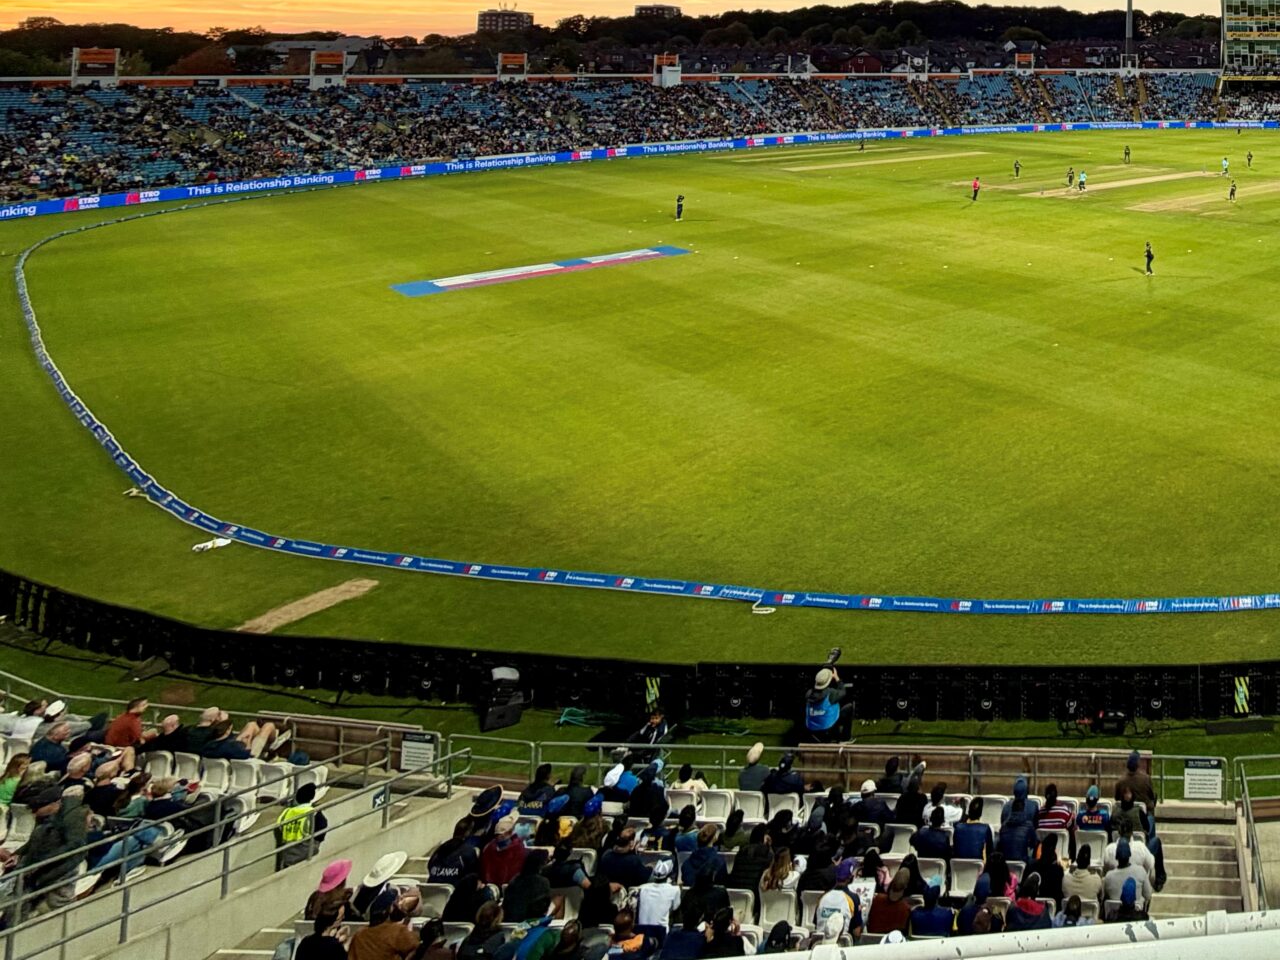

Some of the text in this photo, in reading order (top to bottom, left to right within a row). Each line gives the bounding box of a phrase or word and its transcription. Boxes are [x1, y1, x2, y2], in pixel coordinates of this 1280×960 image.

[827, 132, 862, 140] Relationship
[666, 142, 707, 152] Relationship
[445, 162, 464, 170] This
[474, 157, 524, 168] Relationship
[525, 154, 556, 164] Banking
[354, 169, 382, 180] METRO
[400, 165, 426, 176] METRO
[187, 174, 334, 196] This is Relationship Banking
[126, 191, 160, 205] METRO
[64, 197, 100, 212] METRO
